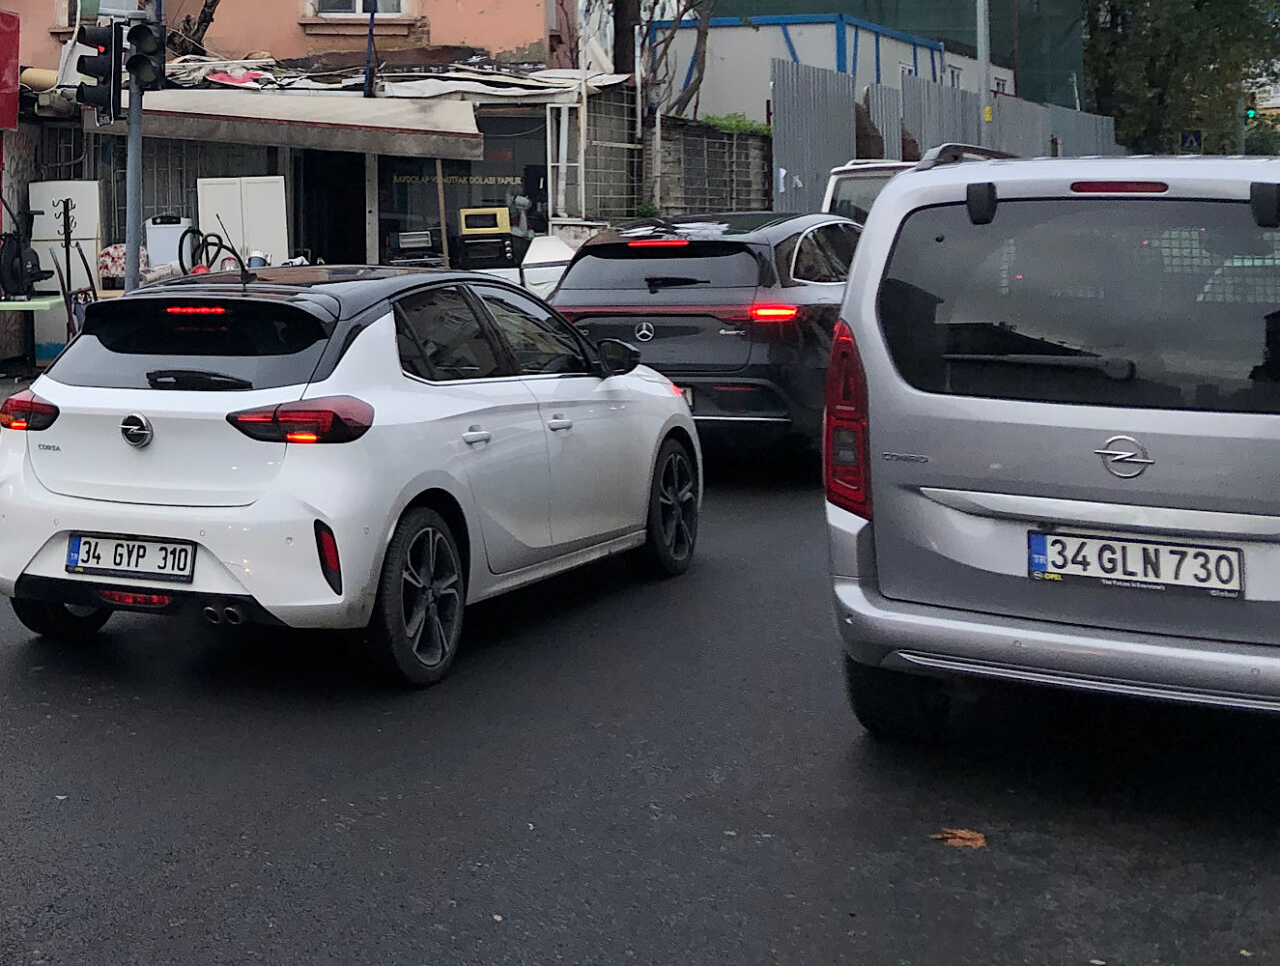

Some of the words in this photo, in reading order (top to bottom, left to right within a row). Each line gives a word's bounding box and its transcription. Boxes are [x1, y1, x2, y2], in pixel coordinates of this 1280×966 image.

[80, 540, 102, 565] 34
[113, 543, 147, 568] GYP
[157, 546, 189, 572] 310
[1050, 538, 1091, 572] 34
[1097, 543, 1161, 579] GLN
[1169, 549, 1235, 585] 730
[1043, 572, 1063, 582] OPEL
